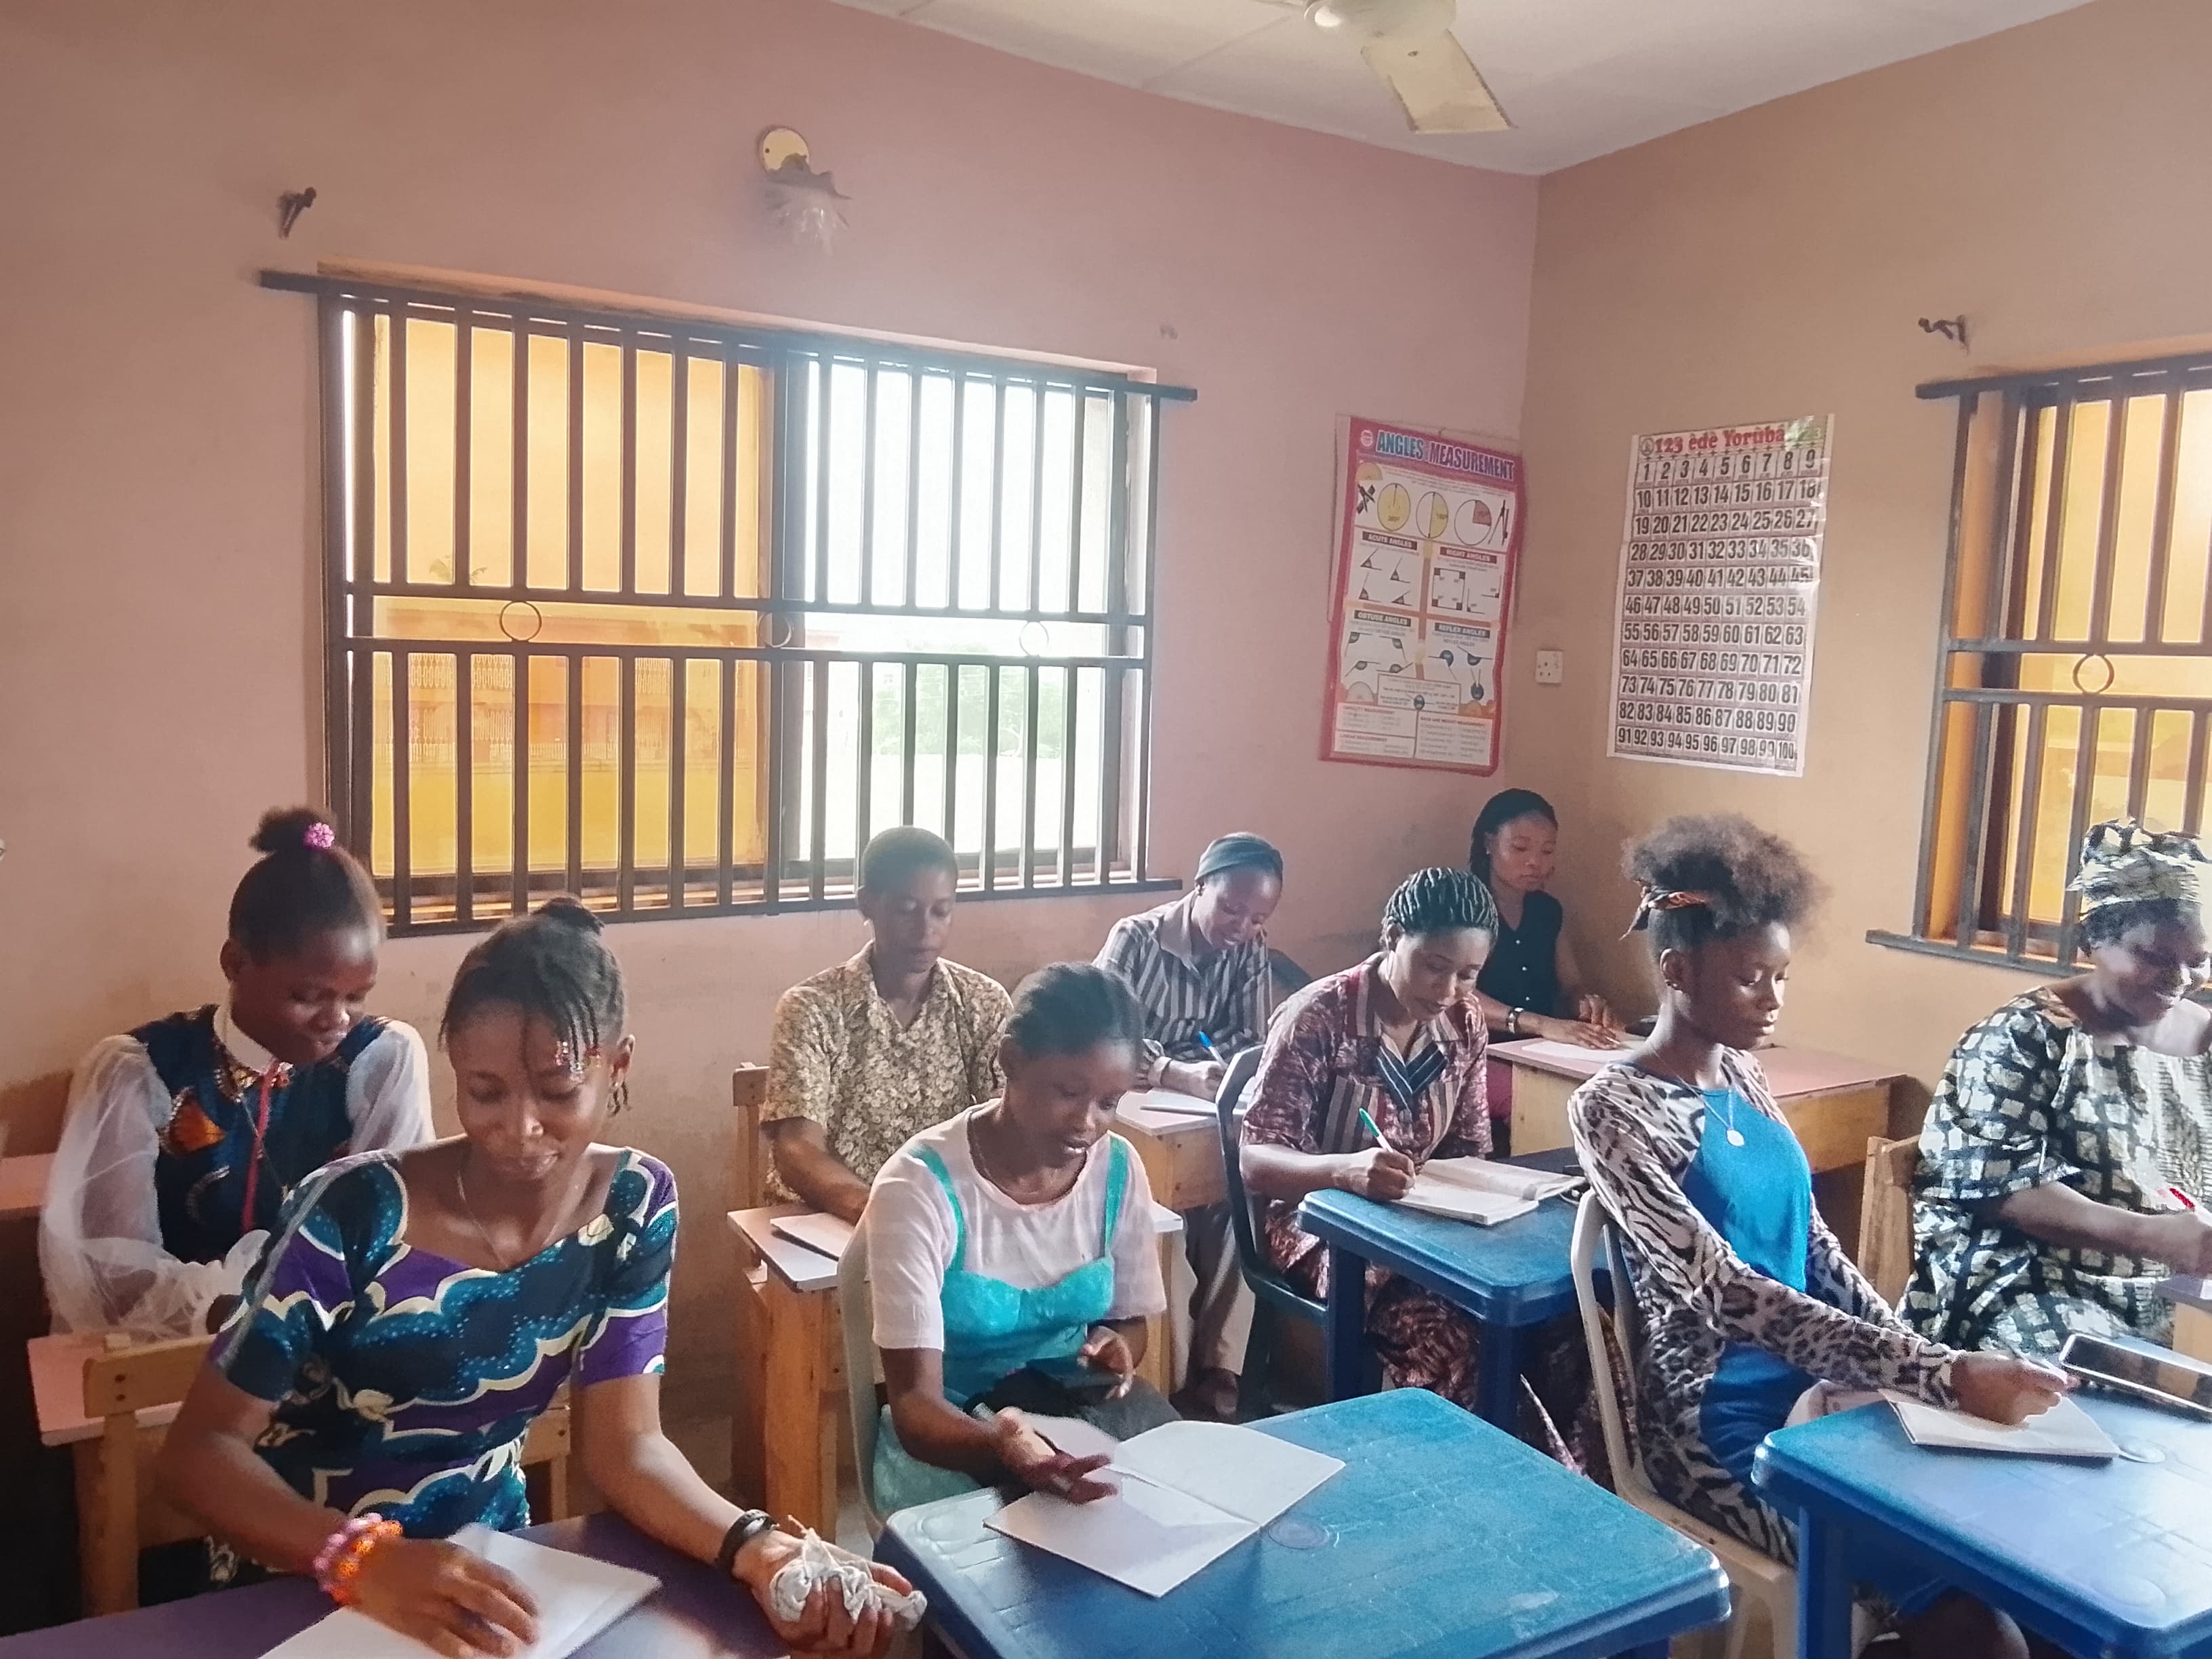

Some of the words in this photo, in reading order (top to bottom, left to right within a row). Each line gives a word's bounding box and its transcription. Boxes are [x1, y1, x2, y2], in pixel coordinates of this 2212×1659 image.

[1376, 430, 1424, 461] ANGLES
[1428, 441, 1515, 479] MEASUREMENT
[1644, 464, 1650, 480] 1
[1661, 462, 1671, 479] 2
[1680, 460, 1689, 478] 3
[1699, 459, 1708, 476] 4
[1720, 457, 1729, 474] 5
[1742, 455, 1750, 473] 6
[1762, 453, 1771, 472] 7
[1784, 451, 1793, 470] 8
[1806, 449, 1815, 468] 9
[1637, 491, 1651, 508] 10
[1656, 489, 1668, 507] 11
[1675, 488, 1688, 506] 12
[1694, 487, 1708, 504] 13
[1714, 485, 1728, 504] 14
[1735, 483, 1750, 502] 15
[1756, 482, 1771, 501] 16
[1778, 480, 1794, 499] 17
[1799, 480, 1816, 498] 18
[1636, 517, 1649, 535] 19
[1653, 516, 1668, 533] 20
[1673, 515, 1687, 532] 21
[1692, 514, 1708, 532] 22
[1711, 514, 1727, 531] 23
[1731, 512, 1748, 531] 24
[1752, 511, 1771, 530] 25
[1774, 510, 1793, 529] 26
[1797, 509, 1815, 528] 27
[1389, 537, 1412, 549] ANGLES
[1631, 544, 1647, 561] 28
[1650, 544, 1666, 560] 29
[1668, 543, 1685, 560] 30
[1689, 542, 1703, 559] 31
[1708, 542, 1725, 560] 32
[1729, 541, 1745, 558] 33
[1749, 540, 1766, 558] 34
[1770, 539, 1788, 558] 35
[1792, 539, 1810, 556] 36
[1466, 551, 1490, 562] ANGLES
[1628, 570, 1644, 587] 37
[1647, 569, 1663, 587] 38
[1666, 569, 1683, 587] 39
[1686, 569, 1703, 587] 40
[1707, 569, 1723, 587] 41
[1727, 568, 1744, 587] 42
[1748, 568, 1765, 586] 43
[1769, 568, 1786, 586] 44
[1626, 596, 1641, 614] 46
[1645, 596, 1660, 613] 47
[1664, 596, 1680, 613] 48
[1684, 596, 1700, 614] 49
[1704, 597, 1720, 615] 50
[1725, 597, 1741, 615] 51
[1746, 596, 1762, 615] 52
[1766, 596, 1784, 616] 53
[1788, 596, 1805, 615] 54
[1384, 615, 1408, 626] ANGLES
[1624, 623, 1639, 640] 55
[1643, 623, 1658, 640] 56
[1662, 624, 1679, 641] 57
[1683, 624, 1698, 642] 58
[1702, 625, 1719, 642] 59
[1723, 625, 1740, 643] 60
[1744, 626, 1759, 644] 61
[1765, 626, 1781, 644] 62
[1786, 626, 1803, 645] 63
[1622, 649, 1637, 667] 64
[1641, 650, 1657, 668] 65
[1661, 651, 1677, 668] 66
[1681, 651, 1696, 669] 67
[1700, 652, 1717, 670] 68
[1721, 653, 1737, 671] 69
[1741, 654, 1757, 672] 70
[1763, 655, 1779, 673] 71
[1784, 655, 1801, 674] 72
[1622, 676, 1637, 693] 73
[1640, 677, 1654, 695] 74
[1659, 678, 1674, 695] 75
[1679, 679, 1694, 697] 76
[1698, 680, 1714, 698] 77
[1717, 681, 1734, 699] 78
[1738, 682, 1755, 701] 79
[1759, 683, 1776, 702] 80
[1781, 684, 1797, 703] 81
[1620, 703, 1634, 720] 82
[1637, 703, 1652, 720] 83
[1656, 705, 1671, 722] 84
[1676, 706, 1691, 724] 85
[1696, 708, 1711, 725] 86
[1715, 709, 1732, 727] 87
[1736, 710, 1753, 729] 88
[1757, 712, 1774, 731] 89
[1778, 714, 1795, 732] 90
[1618, 728, 1631, 743] 91
[1634, 730, 1647, 745] 92
[1650, 731, 1663, 746] 93
[1667, 732, 1682, 748] 94
[1685, 734, 1698, 750] 95
[1704, 735, 1717, 752] 96
[1721, 737, 1736, 754] 97
[1740, 739, 1755, 755] 98
[1759, 740, 1774, 757] 99
[1779, 742, 1794, 759] 100
